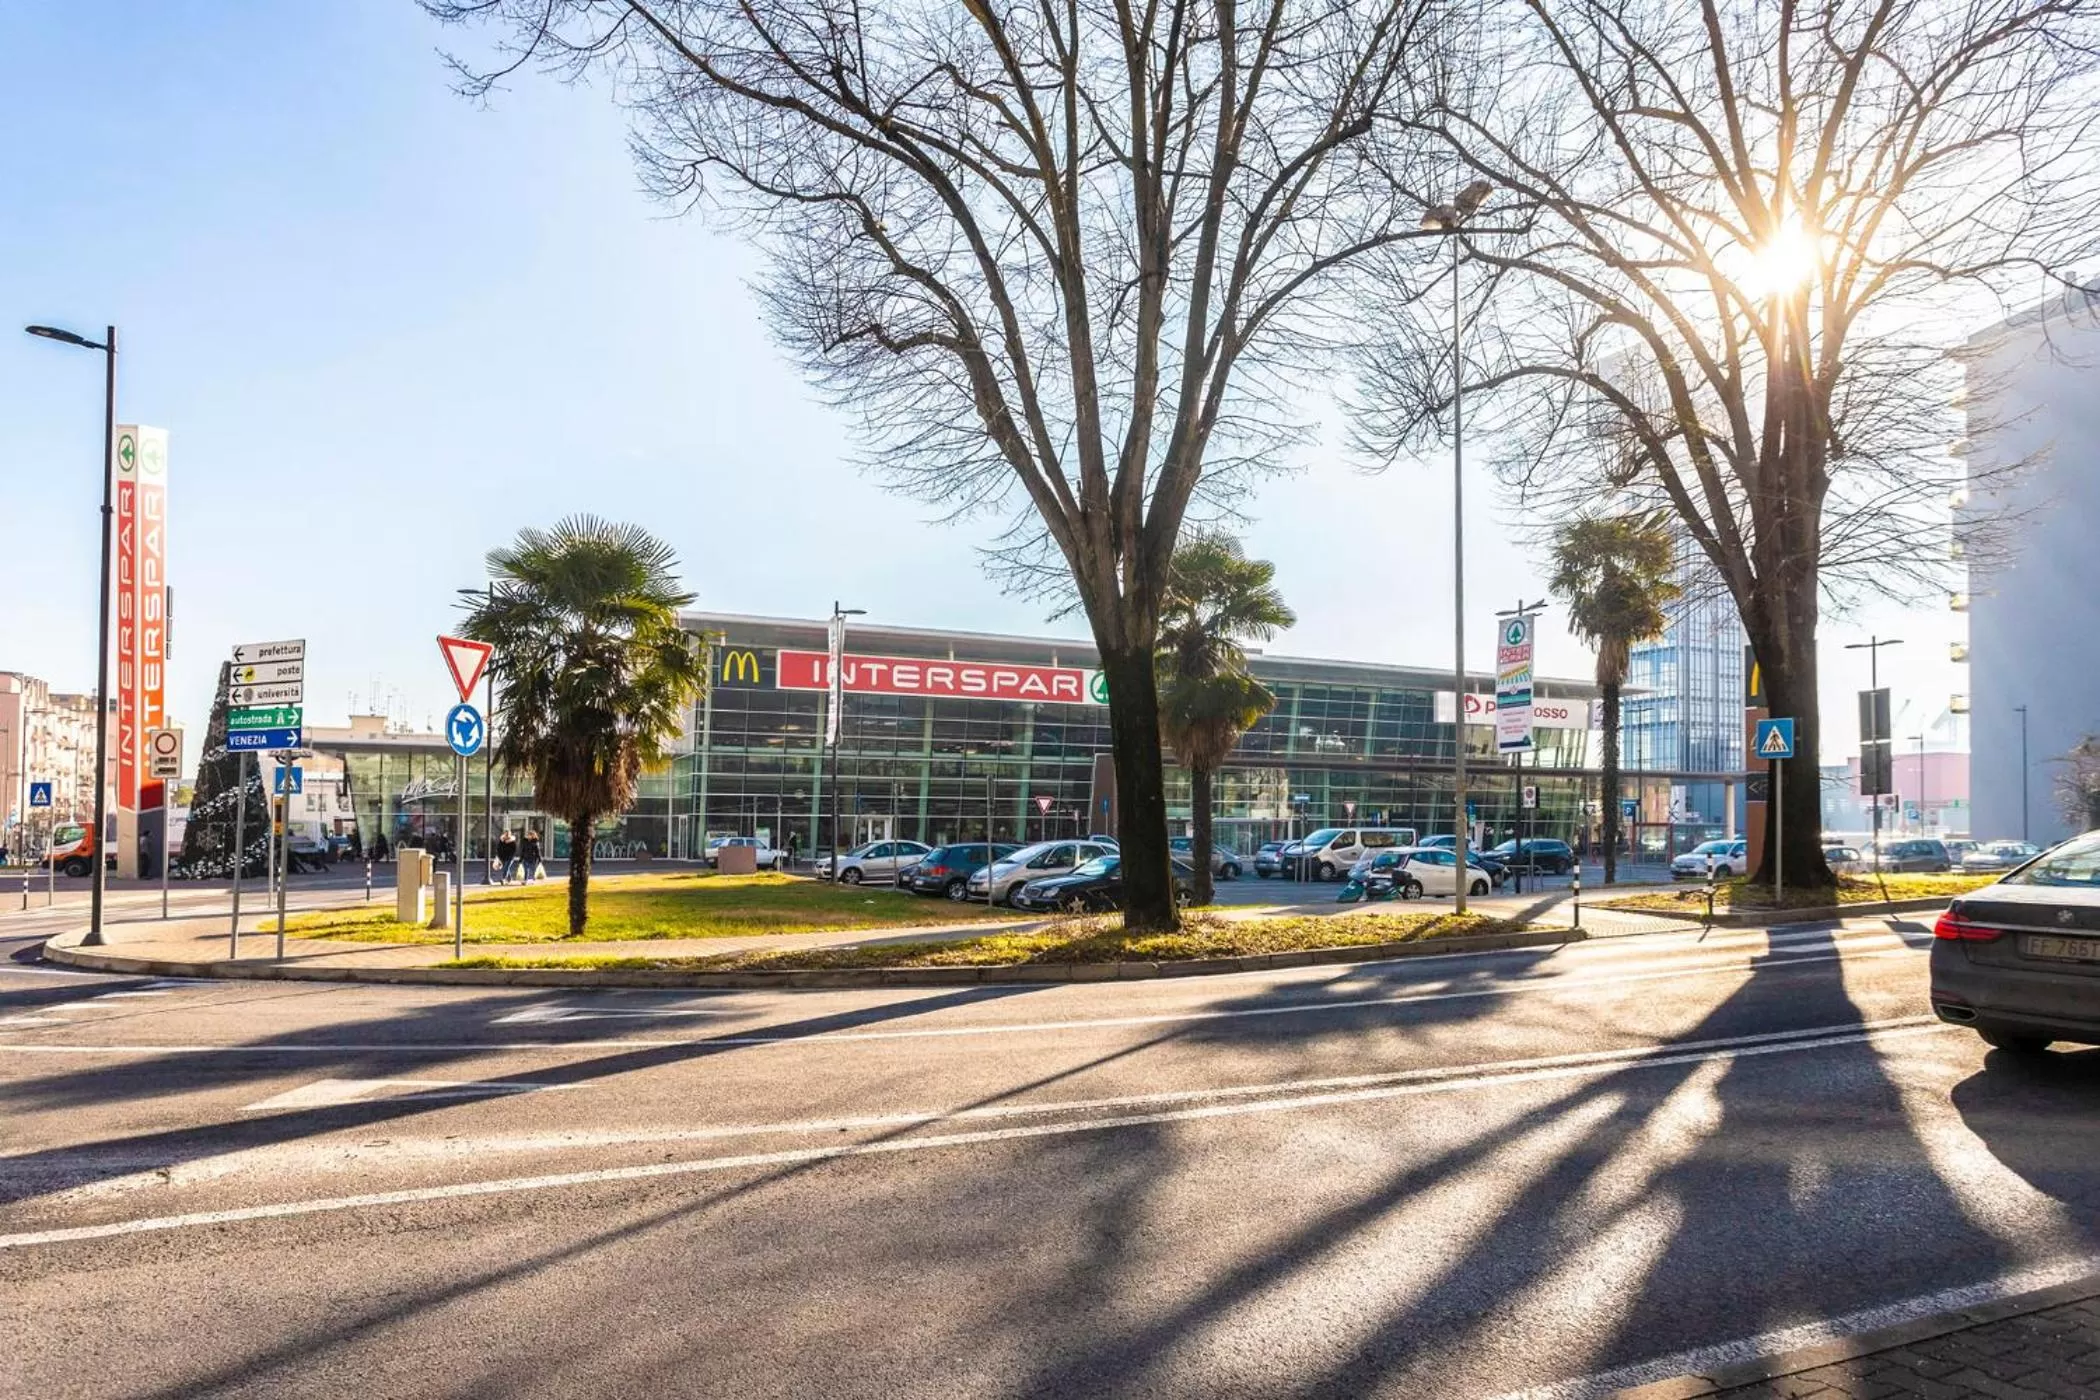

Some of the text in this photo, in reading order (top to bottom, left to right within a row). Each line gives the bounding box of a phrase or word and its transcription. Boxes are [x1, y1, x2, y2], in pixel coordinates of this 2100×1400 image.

[121, 487, 133, 767] INTERSPAR
[144, 490, 161, 768] TERSPAR
[259, 645, 301, 657] prefettura
[277, 666, 300, 676] poste
[813, 659, 1078, 697] INTERSPAR
[257, 686, 299, 698] università
[230, 714, 272, 725] autostrada
[229, 735, 267, 746] VENEZIA
